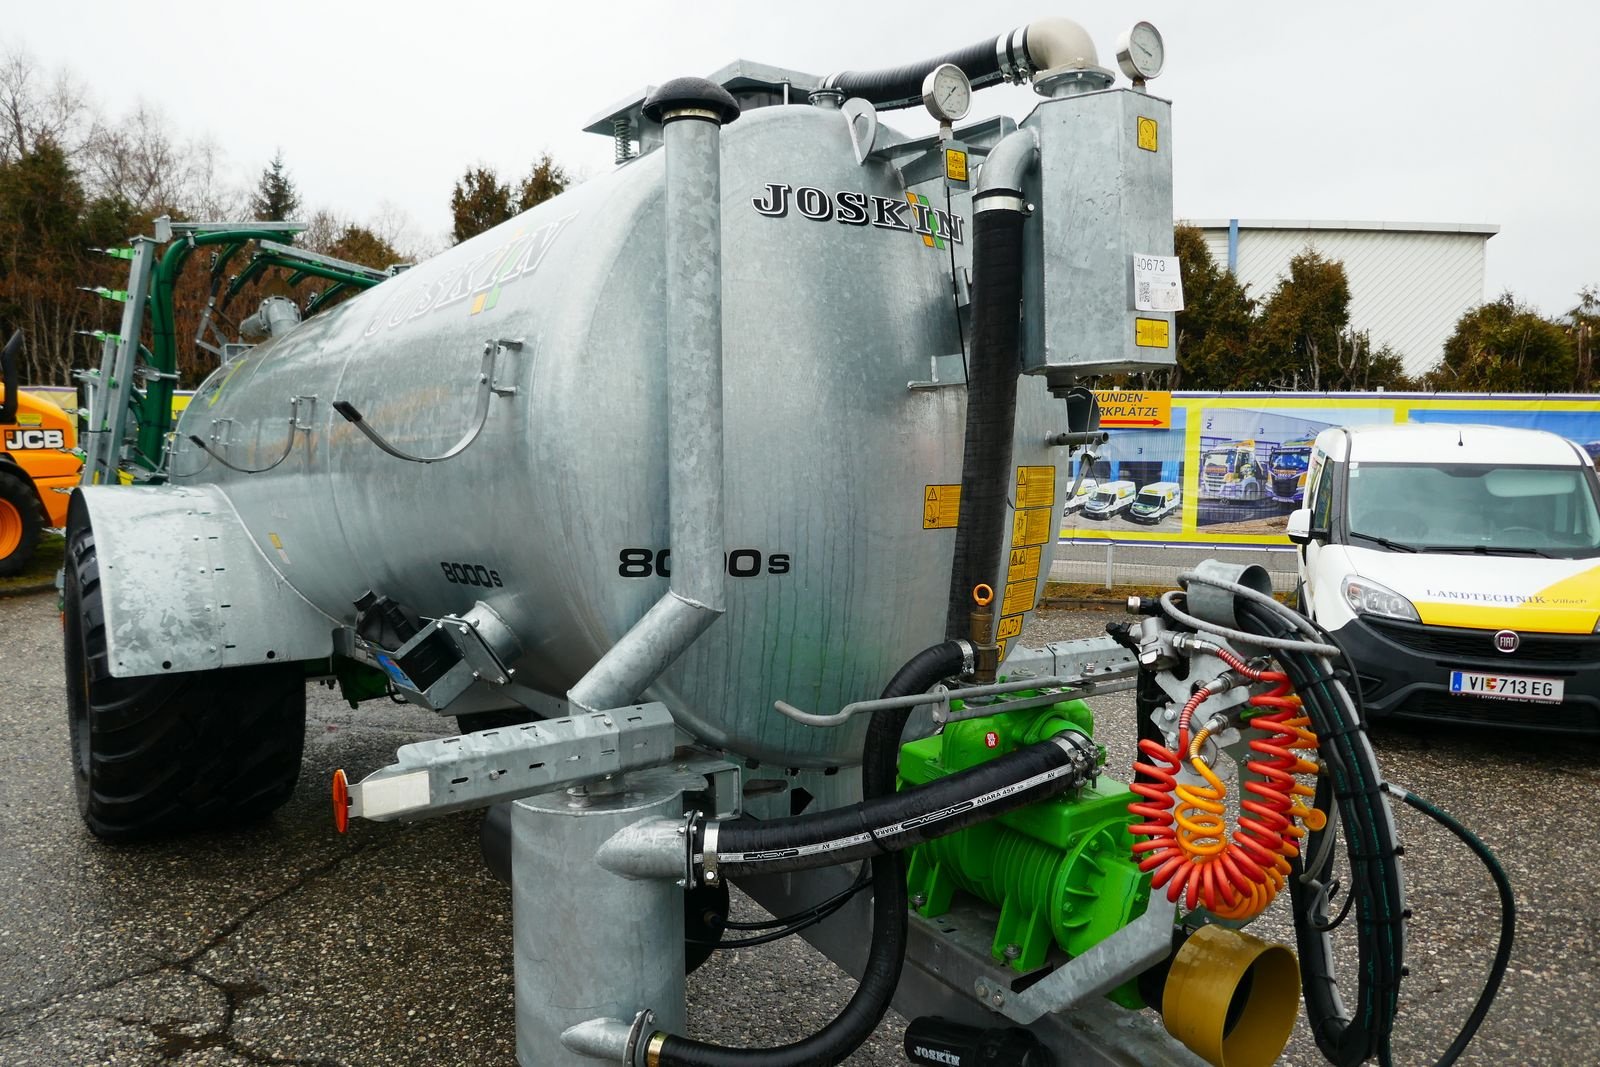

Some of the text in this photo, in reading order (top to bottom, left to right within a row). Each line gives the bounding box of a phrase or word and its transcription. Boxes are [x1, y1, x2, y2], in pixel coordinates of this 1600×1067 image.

[751, 183, 965, 245] JOSKIN
[1100, 404, 1159, 417] RKPLÄTZE
[6, 430, 64, 449] JCB
[618, 548, 790, 578] 80s
[1500, 637, 1514, 647] FIAT
[1469, 676, 1484, 691] VI
[1499, 679, 1527, 694] 713
[1531, 682, 1552, 696] EG
[976, 792, 1001, 805] ADARA
[913, 1046, 960, 1067] JOSKIN
